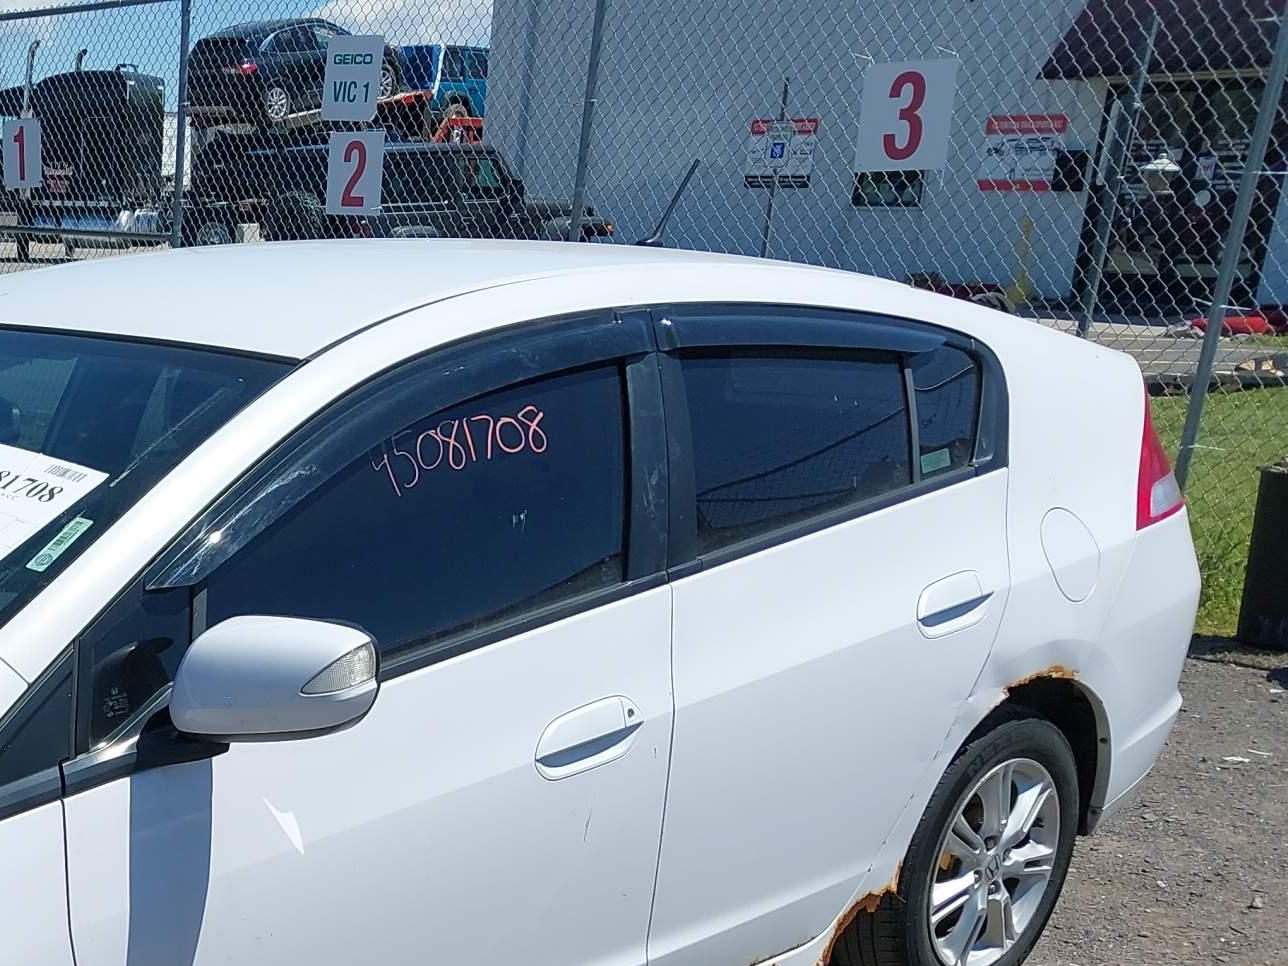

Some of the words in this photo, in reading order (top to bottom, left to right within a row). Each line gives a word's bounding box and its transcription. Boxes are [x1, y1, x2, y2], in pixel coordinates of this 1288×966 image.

[333, 53, 374, 65] GEICO
[333, 80, 358, 103] VIC
[362, 81, 370, 103] 1
[883, 71, 927, 161] 3
[12, 126, 27, 181] 1
[341, 140, 367, 208] 2
[370, 405, 548, 497] 45081708
